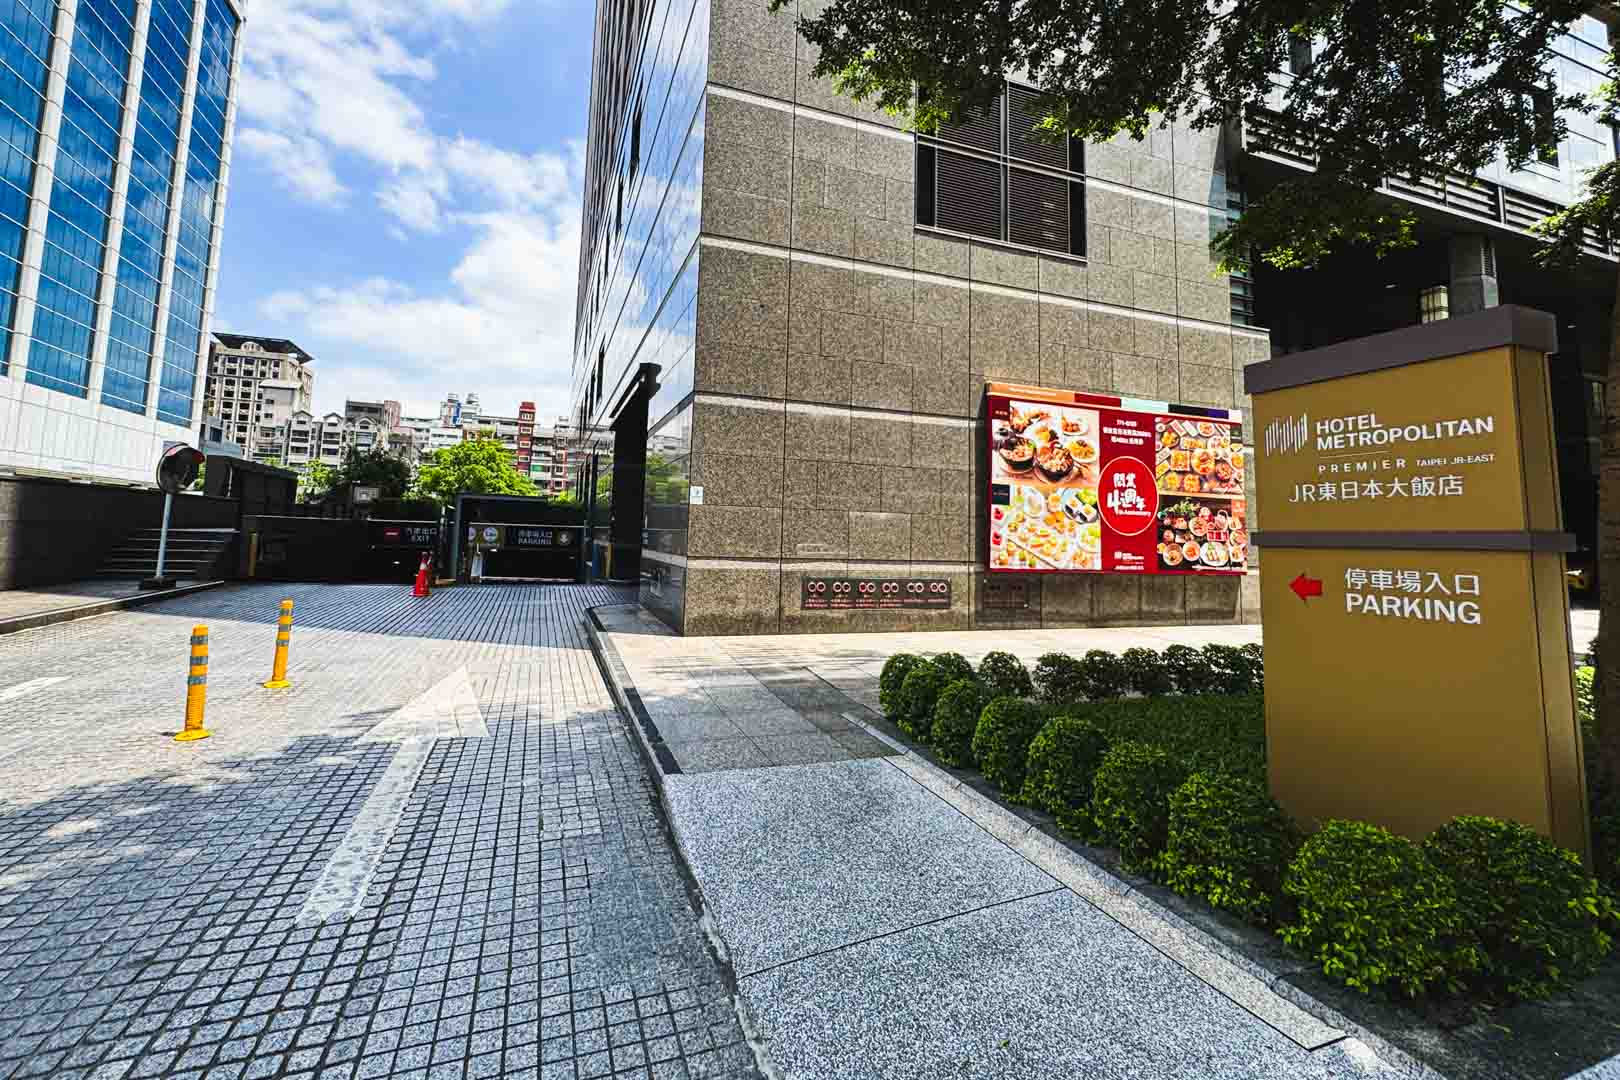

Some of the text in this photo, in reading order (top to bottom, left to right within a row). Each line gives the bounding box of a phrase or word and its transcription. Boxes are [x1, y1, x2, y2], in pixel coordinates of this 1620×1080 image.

[1316, 413, 1383, 435] HOTEL
[1317, 416, 1494, 451] METROPOLITAN
[1318, 453, 1495, 474] PREMIER TAIPEI JR-EAST
[1289, 474, 1464, 503] JR東日本大飯店
[1344, 567, 1480, 596] 停車場入口
[1346, 593, 1481, 625] PARKING
